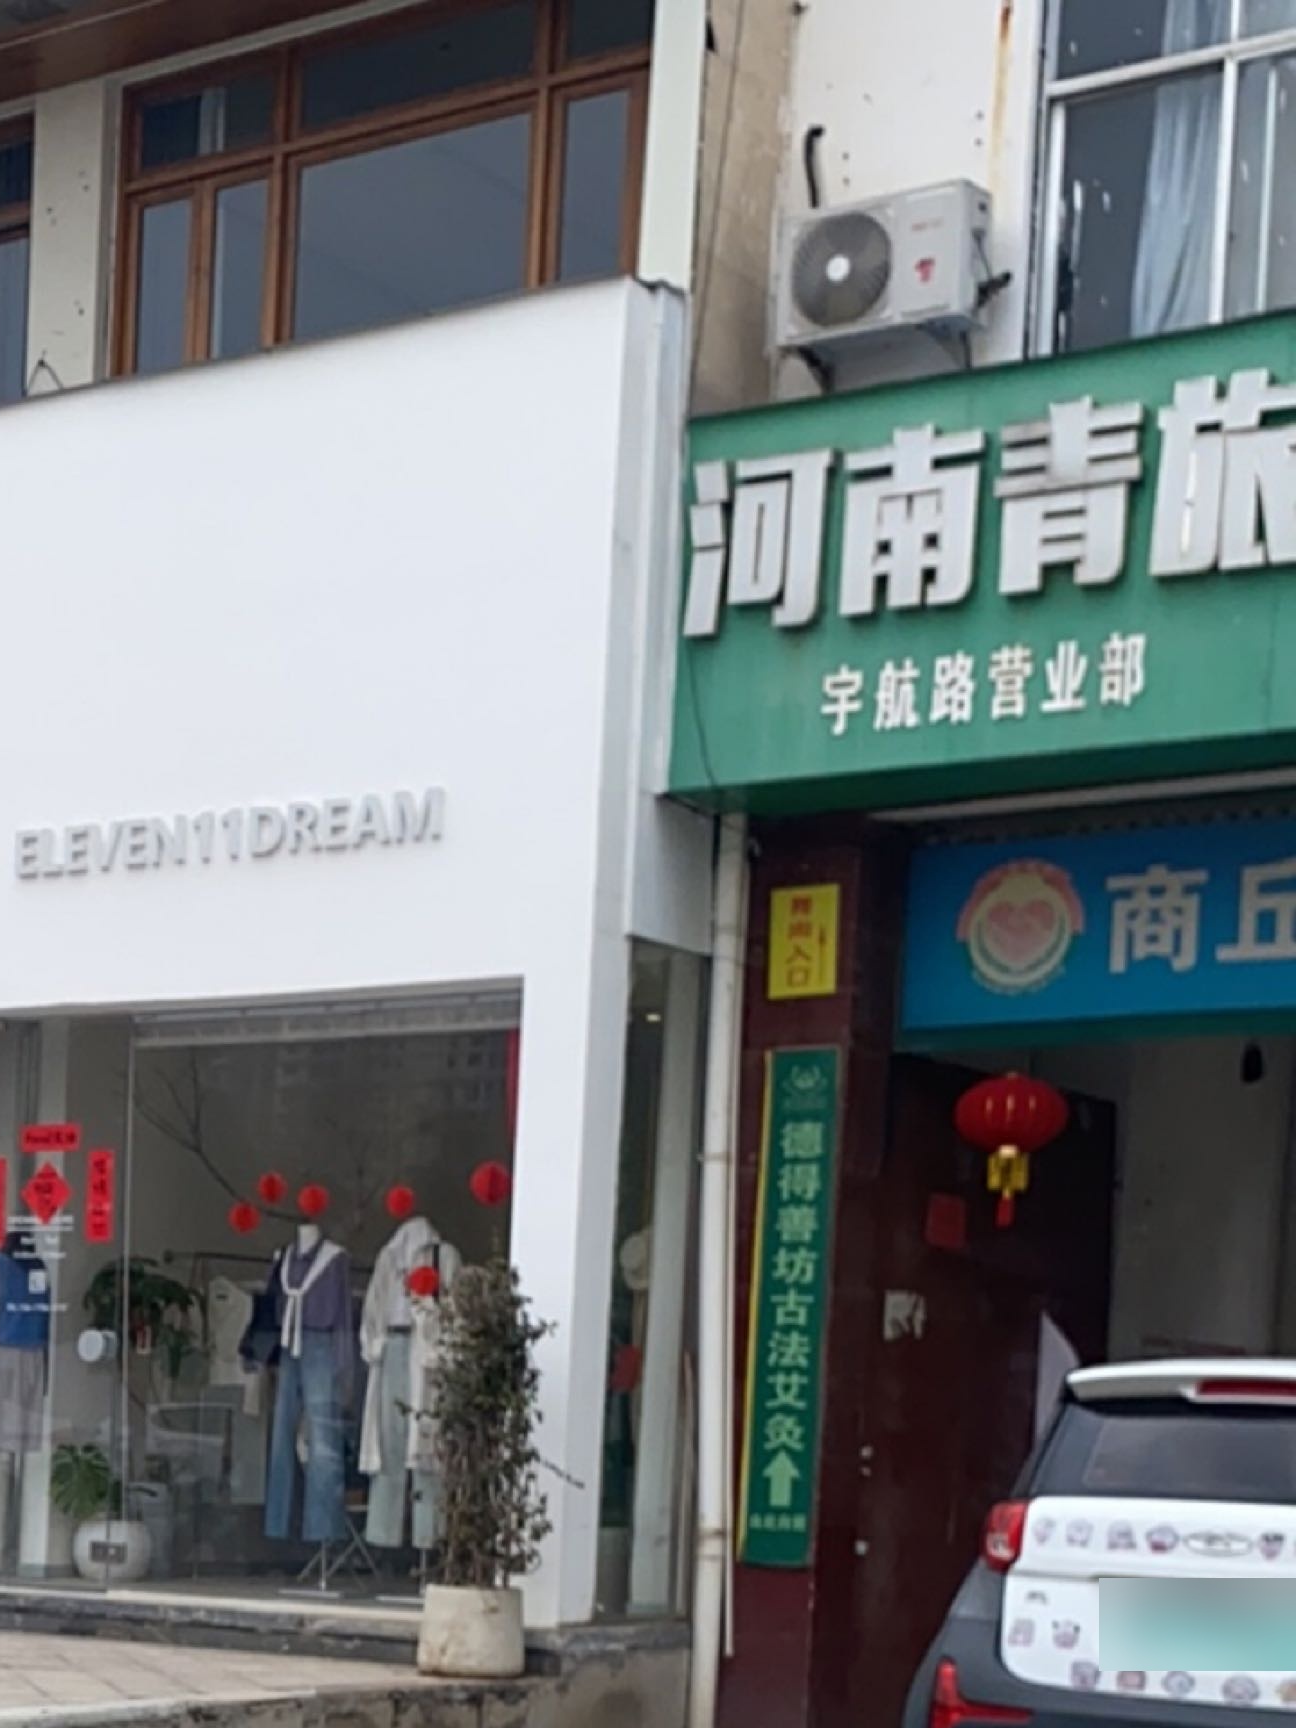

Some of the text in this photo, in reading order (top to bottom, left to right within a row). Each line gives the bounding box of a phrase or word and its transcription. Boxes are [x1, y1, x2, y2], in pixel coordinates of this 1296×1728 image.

[683, 367, 1296, 637] 河南青旅
[820, 632, 1147, 736] 宇航路营业部
[14, 786, 446, 880] ELEVEN11DREAM
[1106, 856, 1296, 974] 商丘
[763, 1120, 824, 1451] 德得善坊古法艾灸
